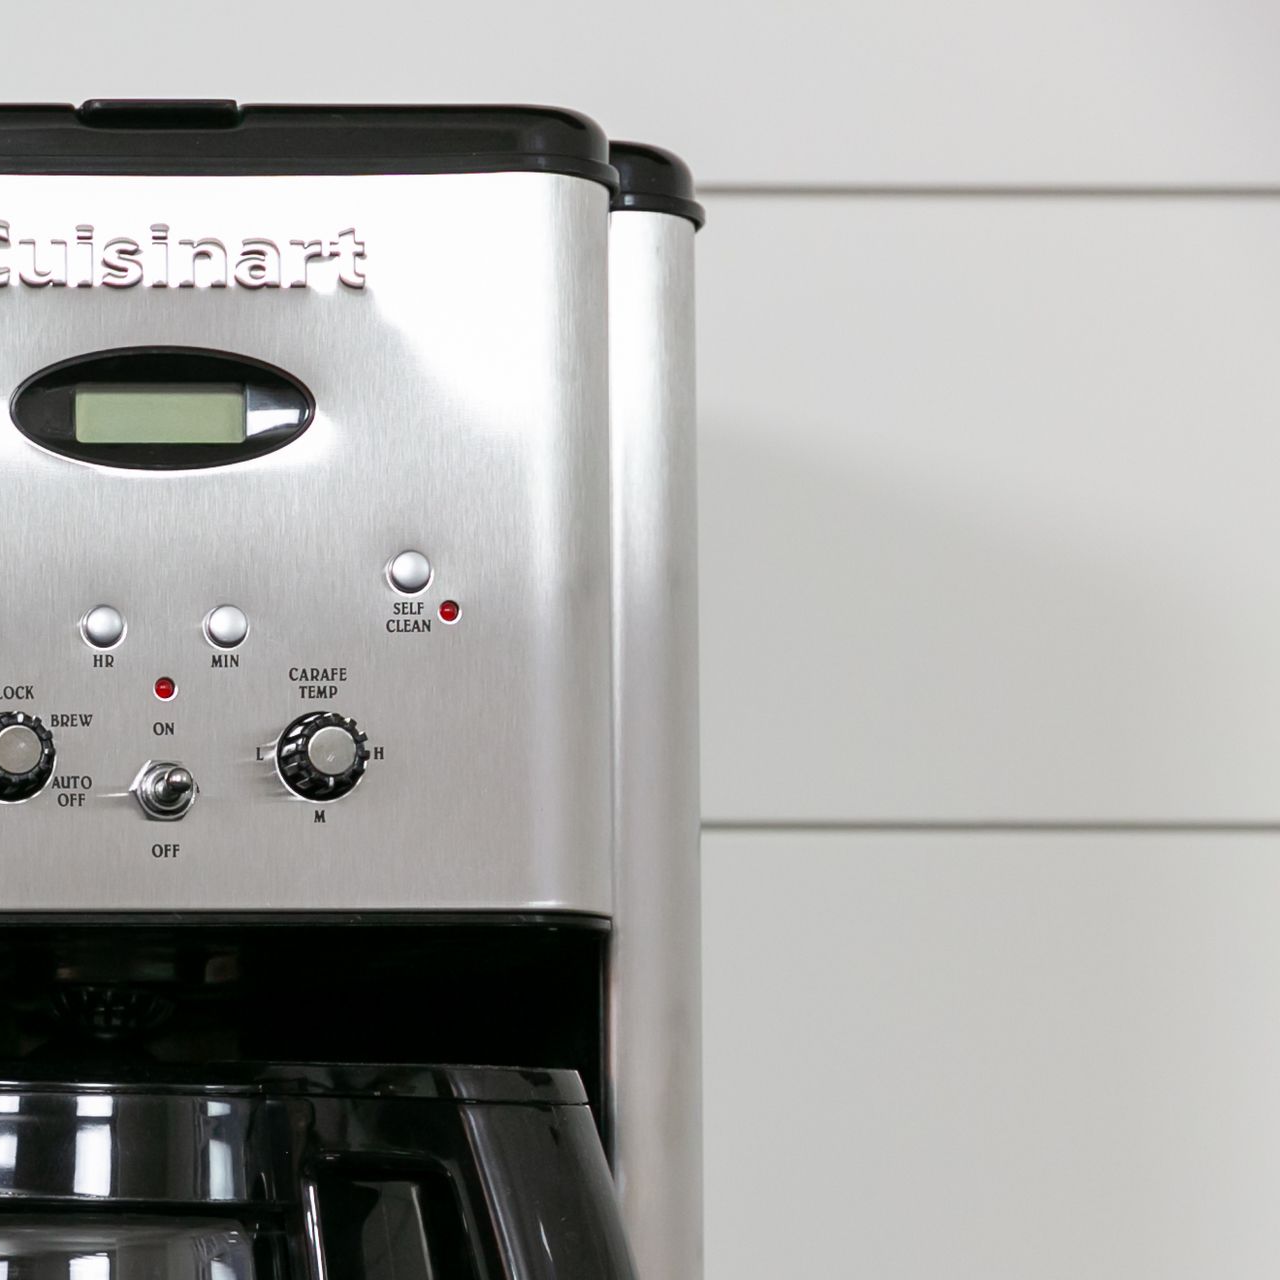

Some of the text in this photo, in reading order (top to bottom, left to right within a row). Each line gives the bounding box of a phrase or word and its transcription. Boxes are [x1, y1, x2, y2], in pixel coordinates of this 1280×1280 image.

[393, 601, 424, 616] SELF
[385, 618, 431, 633] CLEAN
[92, 654, 115, 668] HR
[210, 654, 240, 668] MIN
[288, 667, 347, 682] CARAFE
[298, 685, 338, 699] TEMP
[50, 713, 94, 728] BREW
[152, 721, 175, 736] ON
[255, 746, 265, 761] L
[373, 746, 384, 760] H
[51, 775, 93, 790] AUTO
[56, 792, 86, 808] OFF
[313, 809, 326, 823] M
[151, 843, 181, 858] OFF
